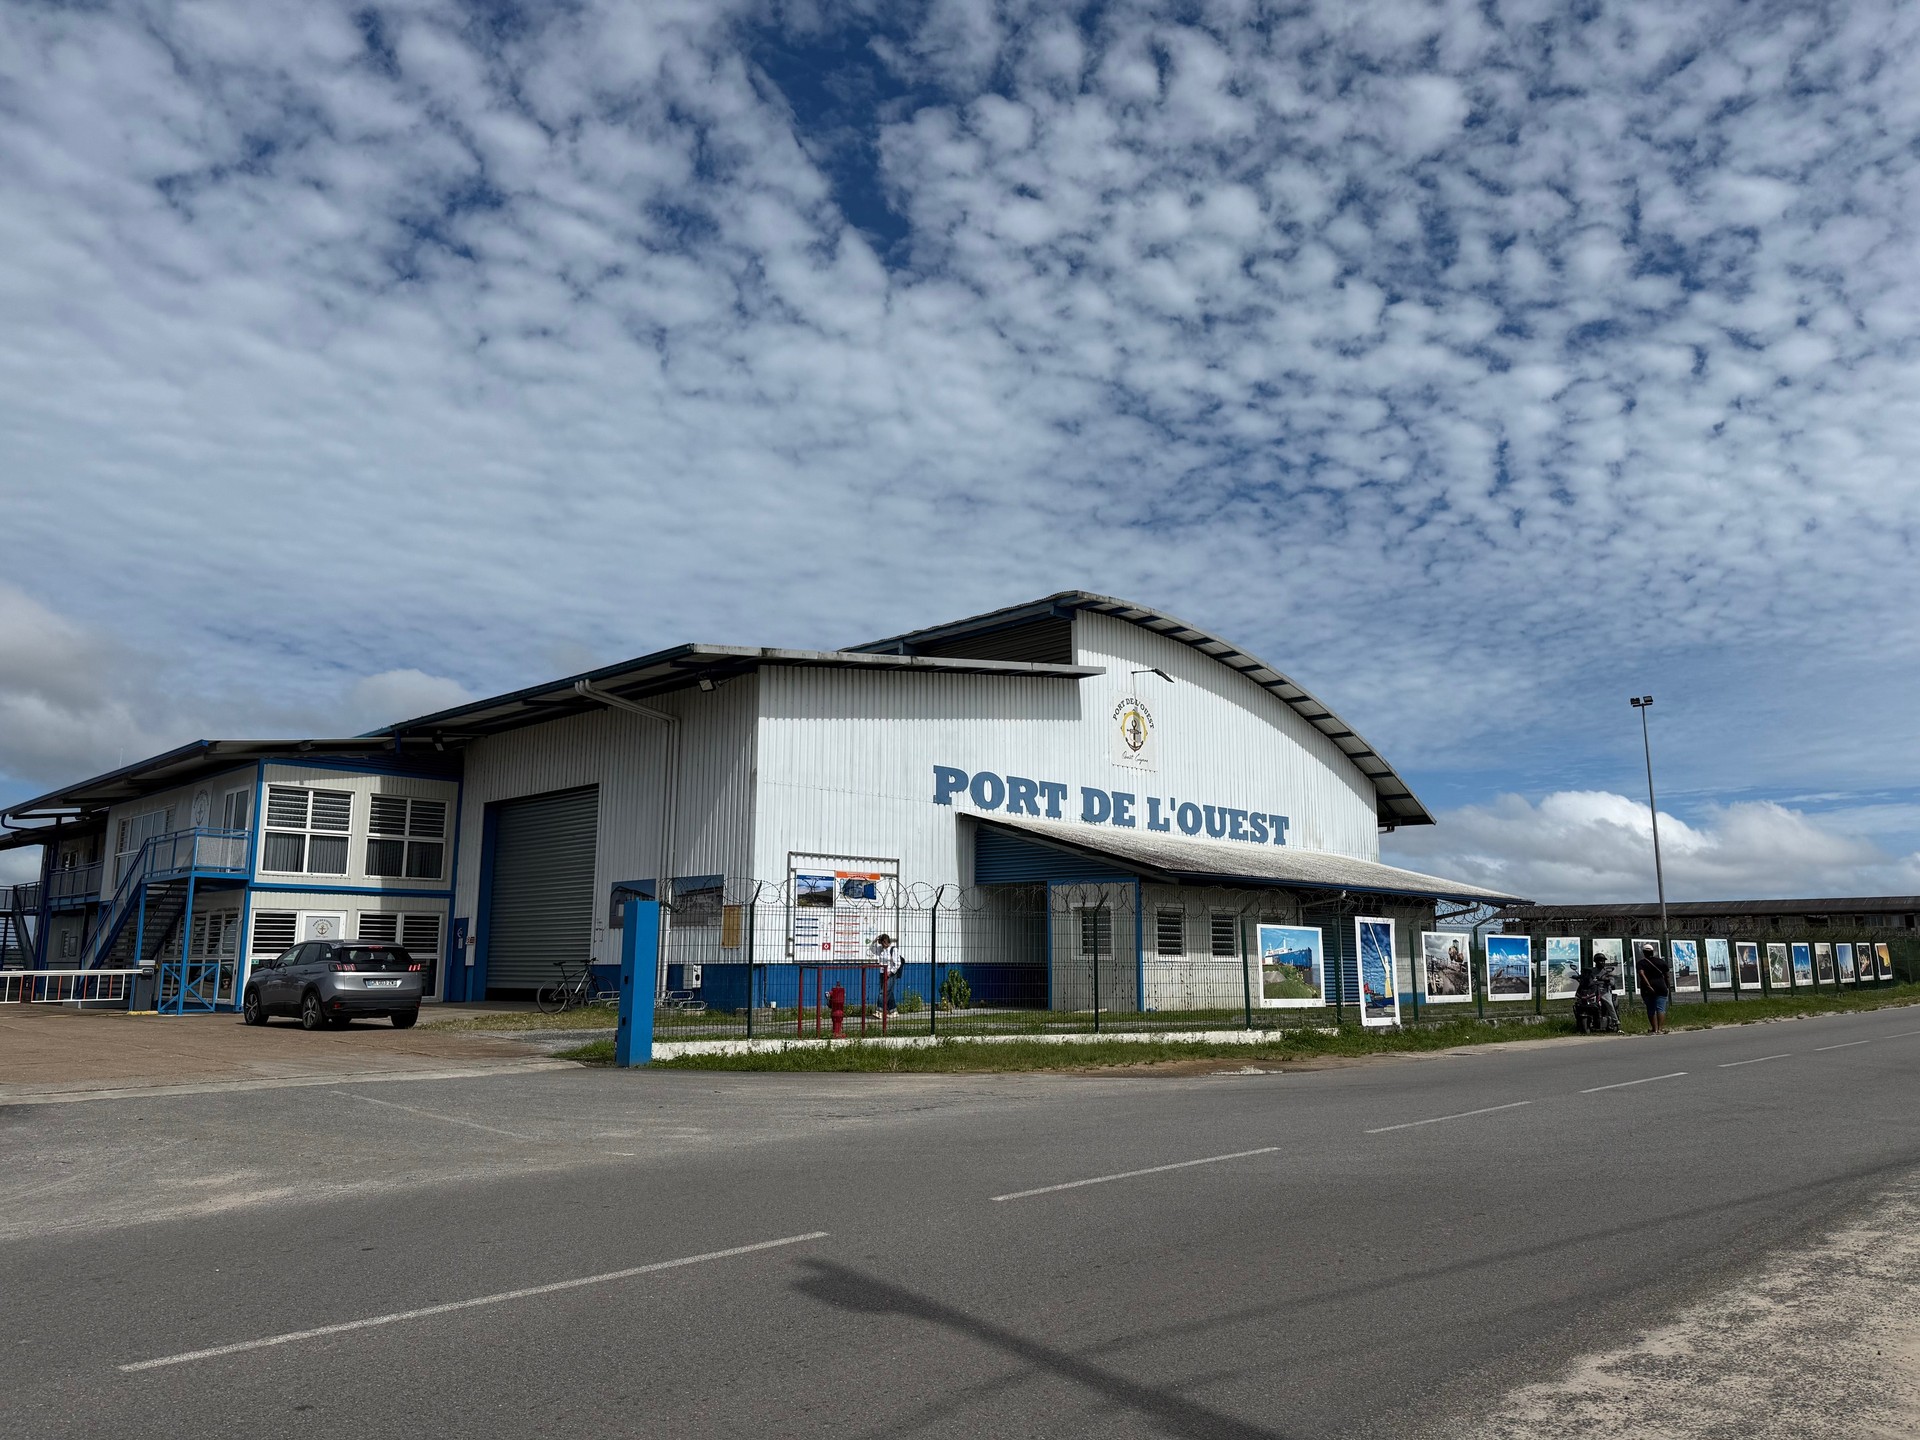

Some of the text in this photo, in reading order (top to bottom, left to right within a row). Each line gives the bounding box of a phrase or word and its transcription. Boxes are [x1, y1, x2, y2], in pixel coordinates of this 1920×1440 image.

[1112, 700, 1125, 721] PORT
[933, 765, 1290, 846] PORT DE L'OUEST
